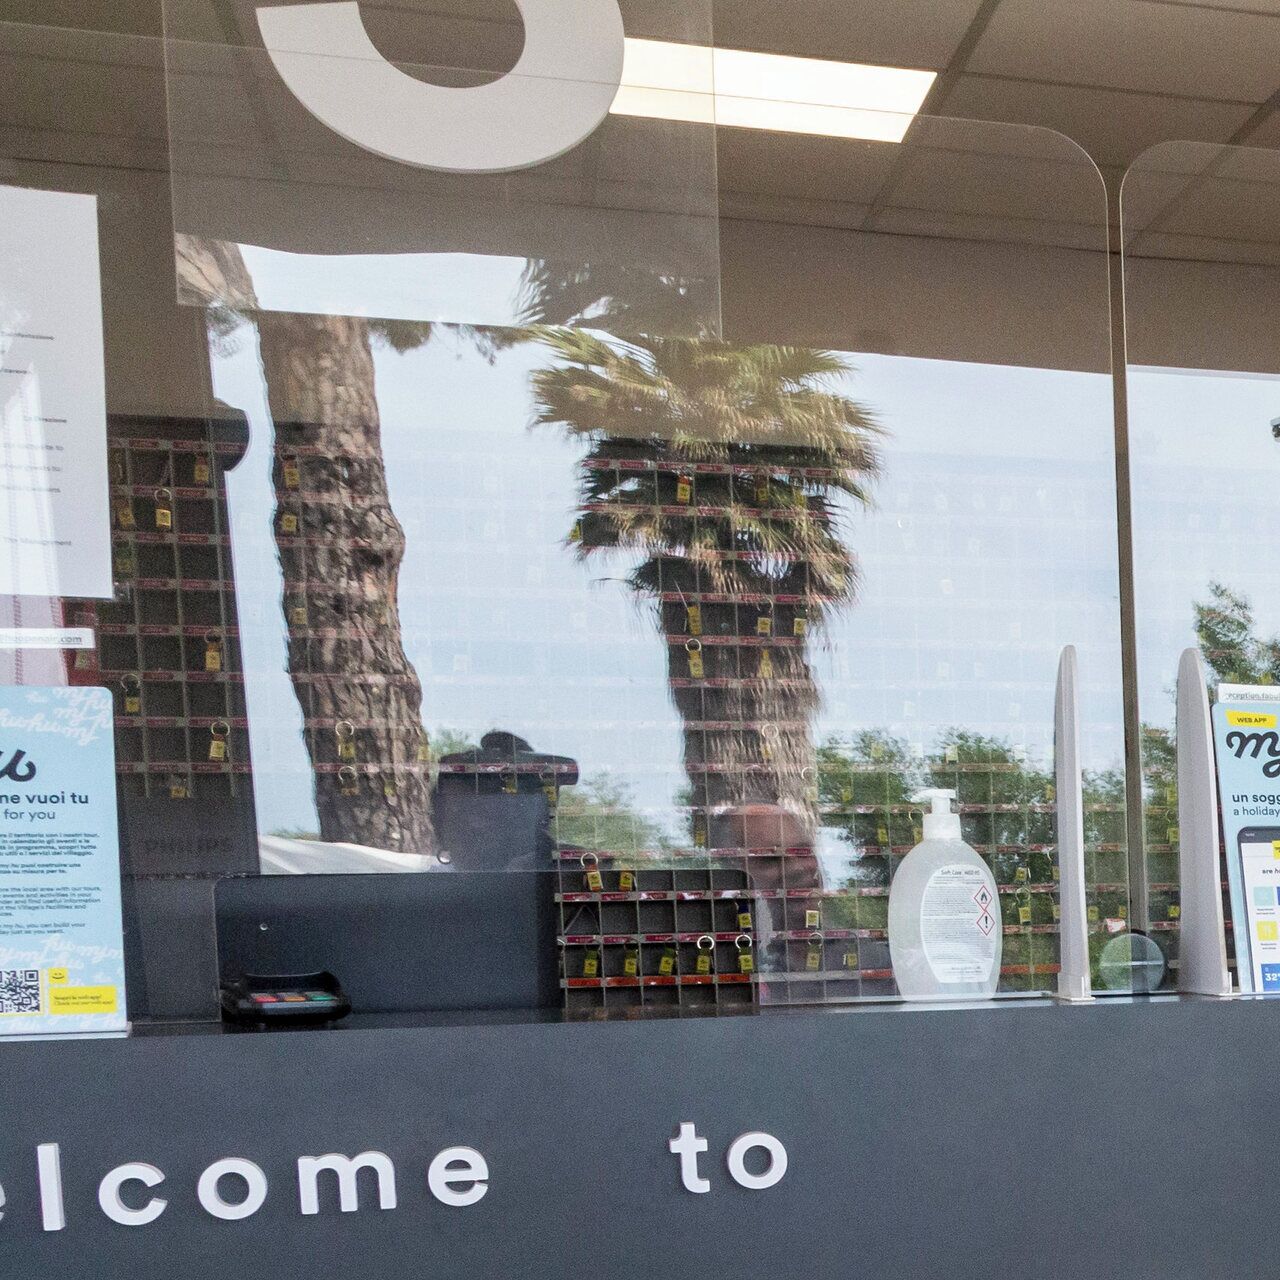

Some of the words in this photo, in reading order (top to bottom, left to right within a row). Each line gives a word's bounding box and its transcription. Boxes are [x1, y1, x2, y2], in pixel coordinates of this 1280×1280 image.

[25, 791, 65, 804] vuoi
[71, 791, 89, 804] tu
[1232, 794, 1248, 803] un
[4, 808, 25, 820] for
[28, 810, 56, 822] you
[1233, 808, 1240, 816] a
[669, 1121, 788, 1194] to
